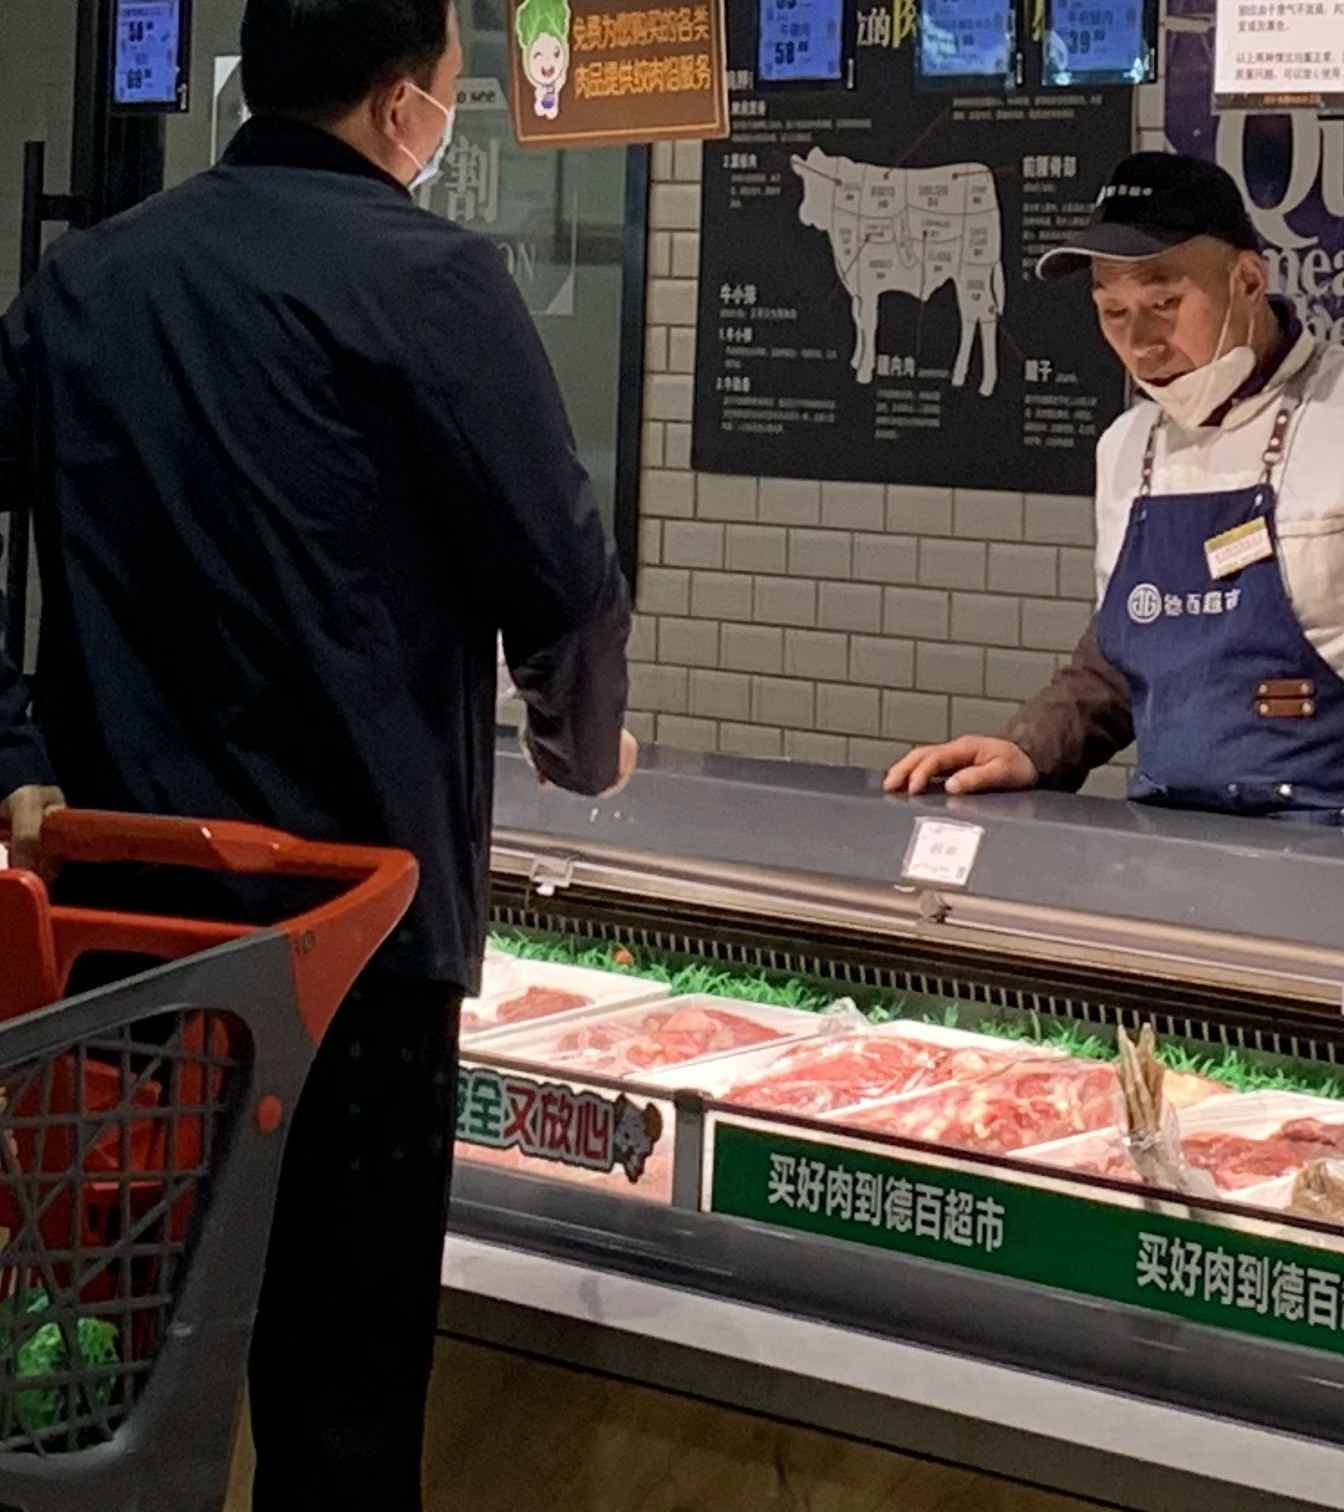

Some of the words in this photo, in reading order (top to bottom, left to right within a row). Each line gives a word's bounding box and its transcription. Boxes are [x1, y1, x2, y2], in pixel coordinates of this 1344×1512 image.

[767, 1151, 1007, 1253] 买好肉到德百超市
